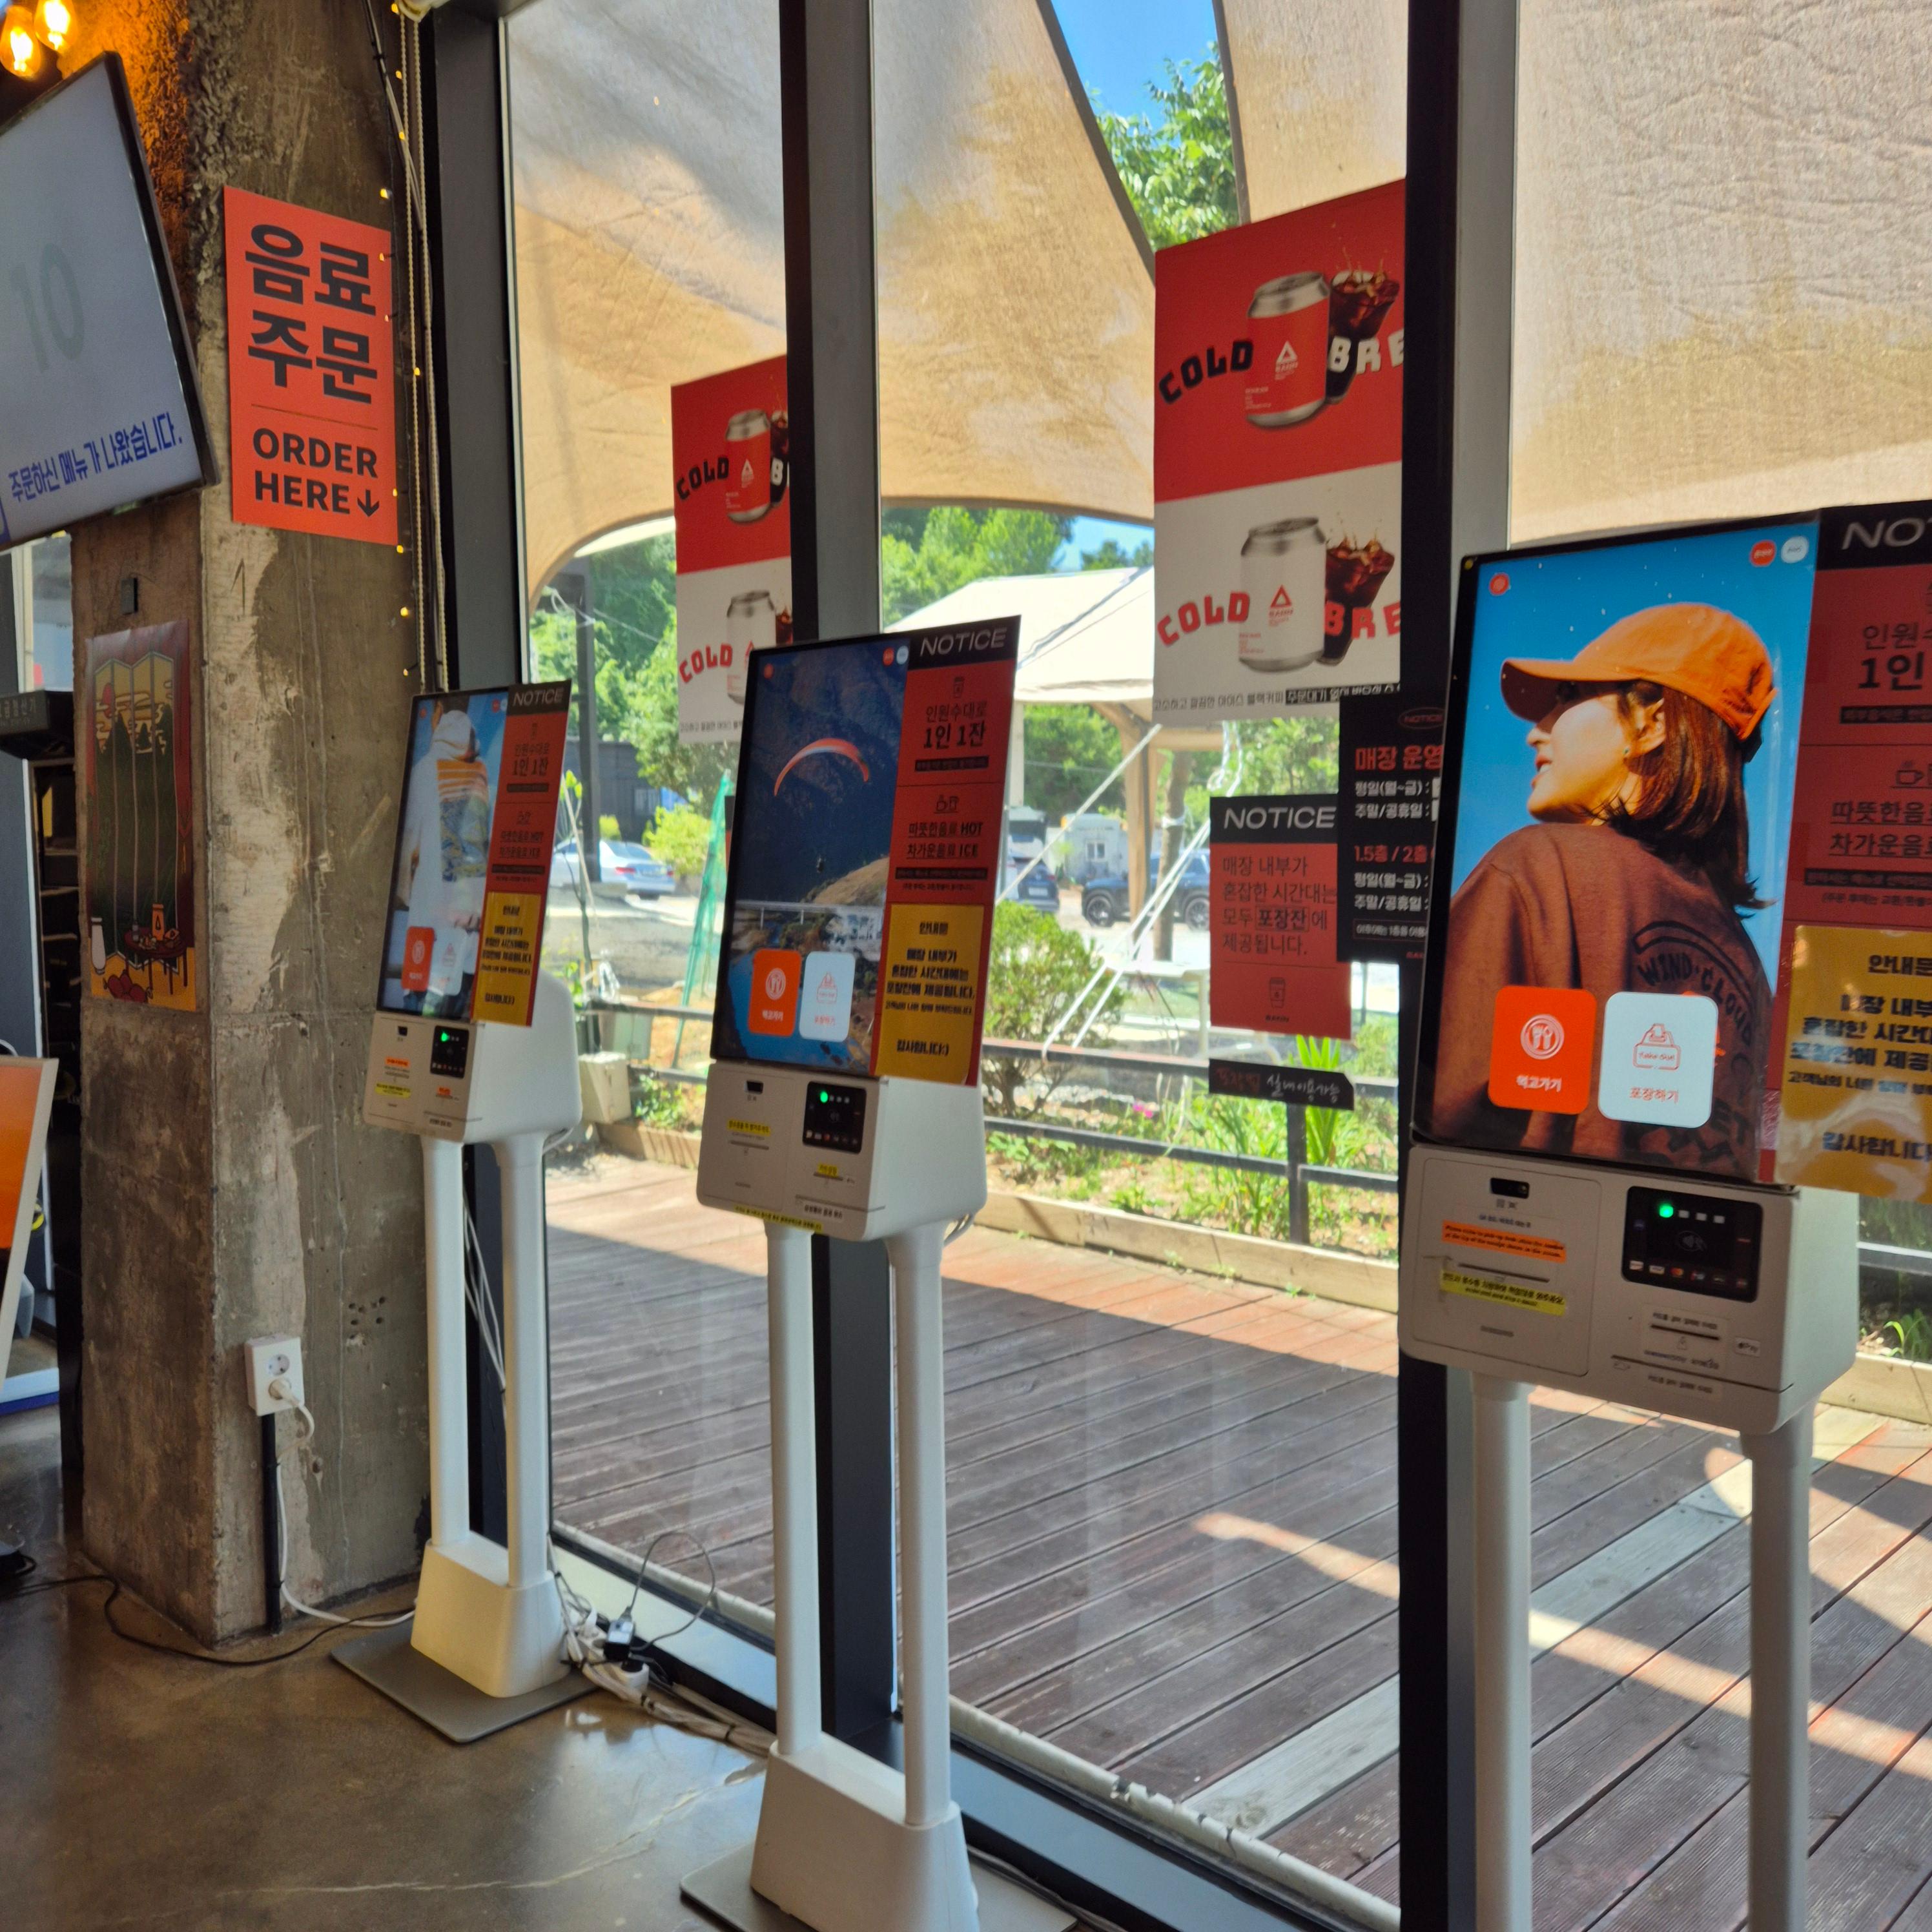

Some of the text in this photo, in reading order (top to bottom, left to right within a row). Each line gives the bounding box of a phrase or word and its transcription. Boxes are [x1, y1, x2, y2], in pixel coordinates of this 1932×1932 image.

[245, 223, 376, 316] 음료
[248, 309, 377, 404] 주문
[1158, 339, 1253, 405] COLD
[8, 457, 60, 502] 주문하신
[101, 411, 182, 469] 나왔습니다.
[252, 427, 378, 478] ORDER
[255, 470, 350, 514] HERE
[676, 457, 729, 500] COLD
[1842, 518, 1932, 549] NO
[1157, 591, 1249, 646] COLD
[920, 628, 1007, 657] NOTICE
[679, 642, 733, 684] COLD
[1858, 652, 1924, 690] 1인
[513, 688, 564, 707] NOTICE
[926, 701, 987, 723] 인원수대로
[923, 720, 985, 750] 1인 1잔
[1355, 746, 1397, 770] 매장
[960, 819, 983, 836] HOT
[1224, 807, 1337, 829] NOTICE
[1223, 856, 1307, 876] 매장 내부가
[1223, 881, 1268, 902] 혼잡한
[1222, 907, 1253, 928] 모두
[1223, 934, 1307, 956] 제공됩니다.
[1516, 1074, 1679, 1104] 먹고가기 포장하기
